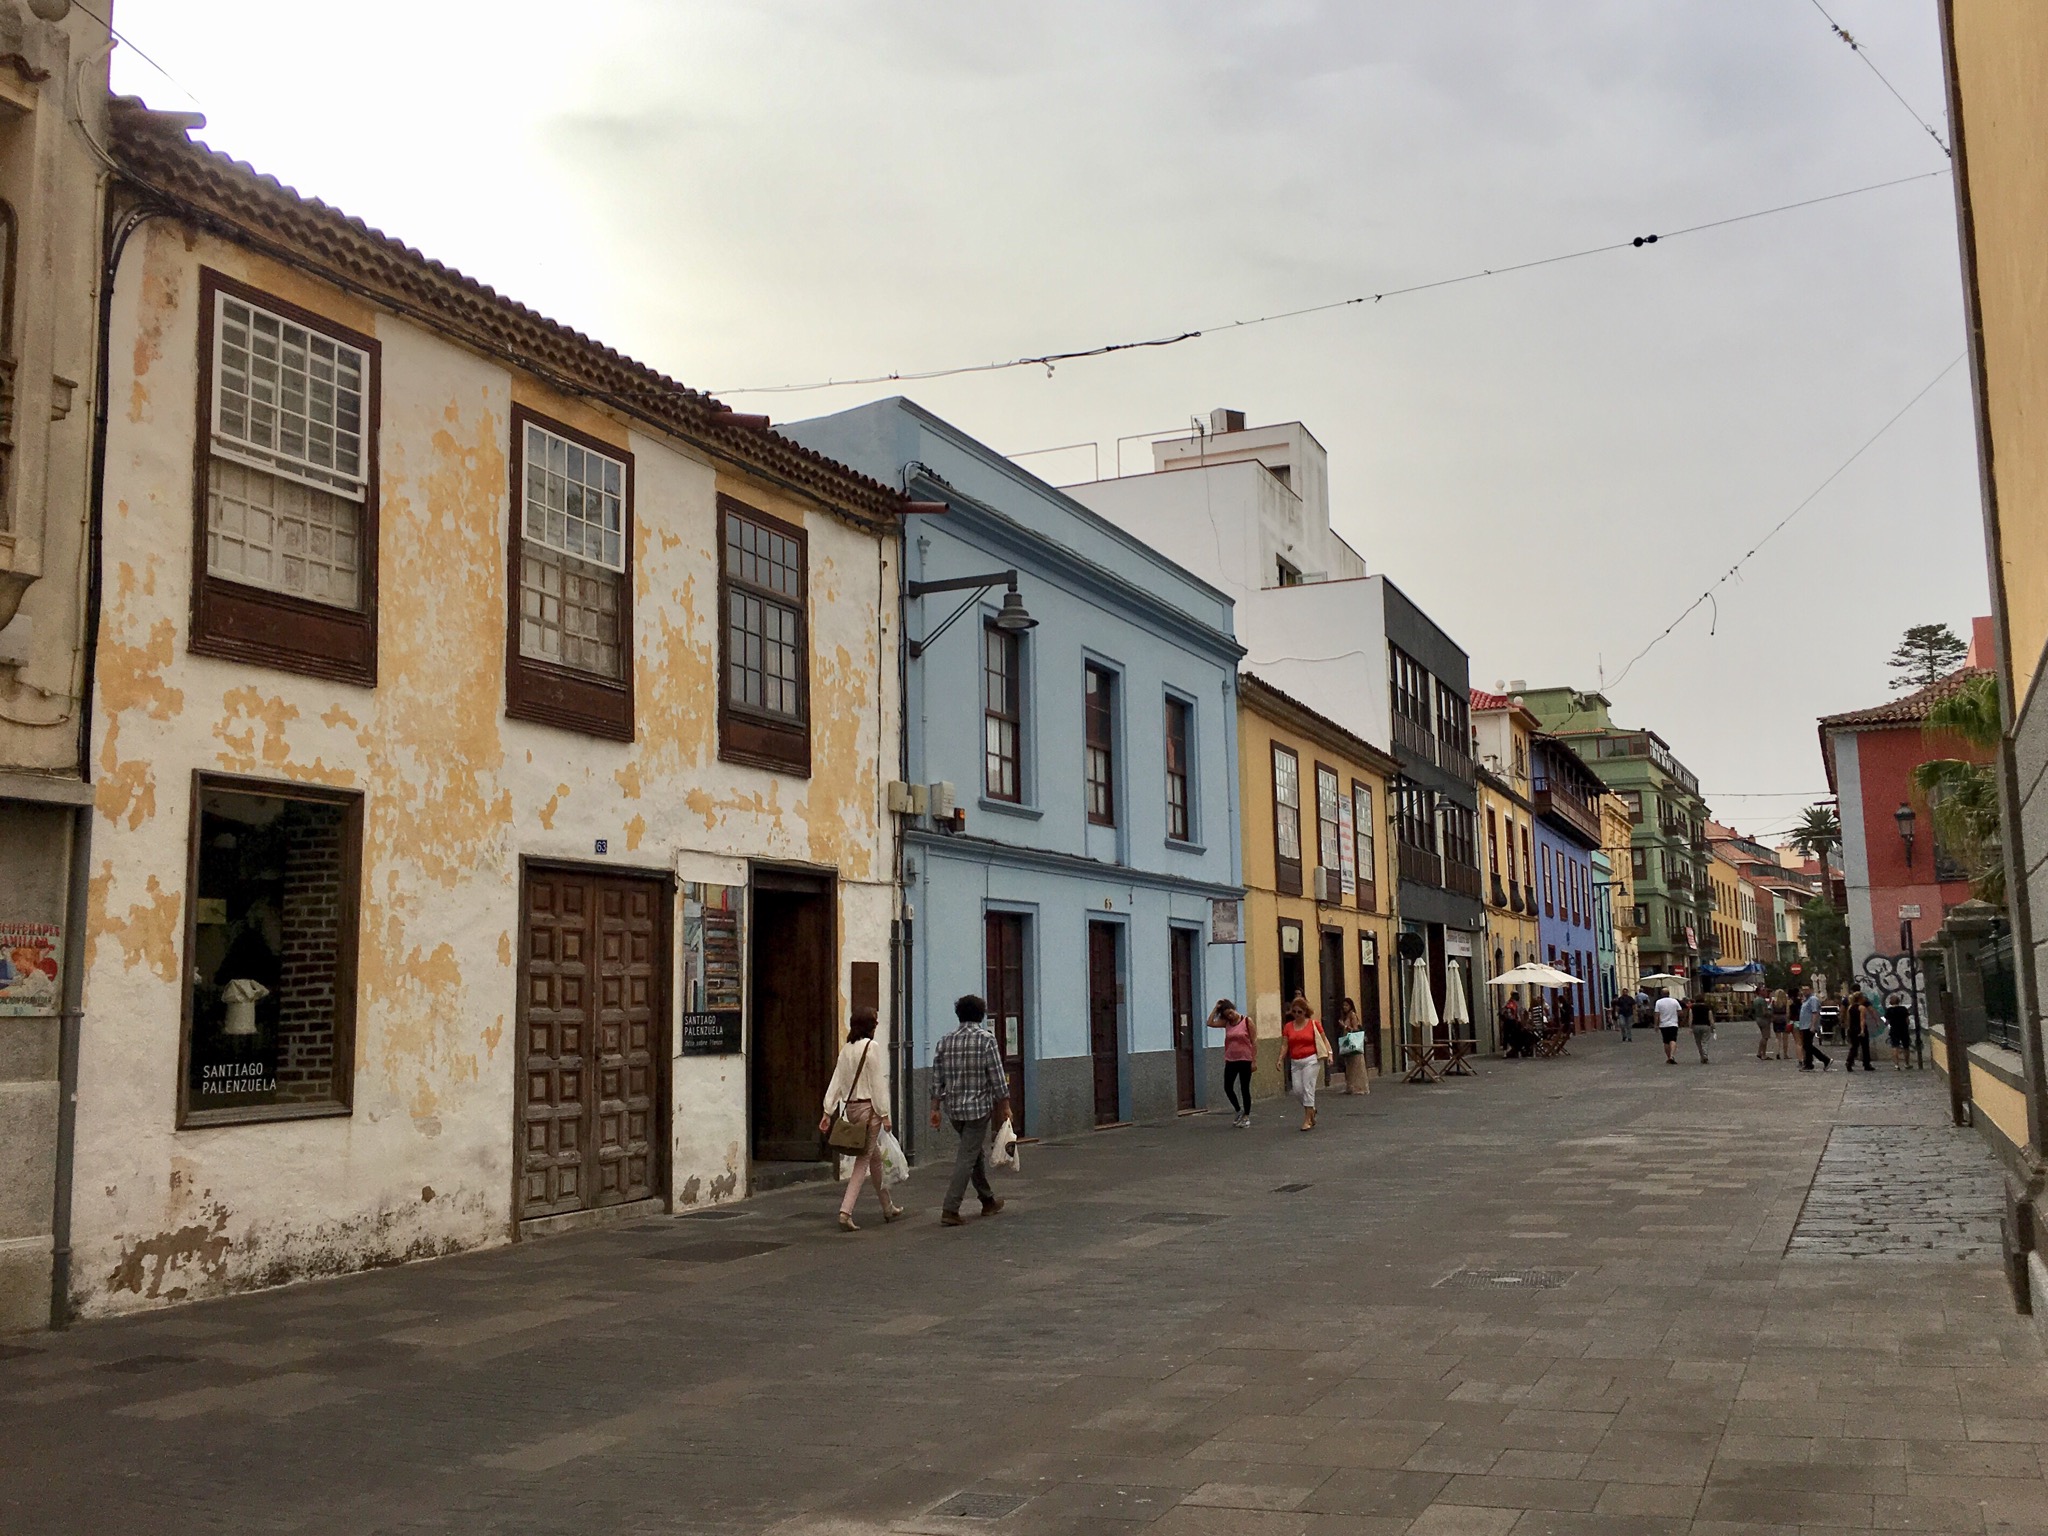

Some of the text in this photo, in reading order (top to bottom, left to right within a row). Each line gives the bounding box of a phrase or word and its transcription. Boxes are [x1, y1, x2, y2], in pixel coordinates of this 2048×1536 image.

[597, 841, 606, 852] 63
[684, 1015, 717, 1025] SANTIAGO
[684, 1026, 724, 1036] PALENZUELA
[203, 1062, 264, 1079] SANTIAGO
[202, 1078, 277, 1095] PALENZUELA
